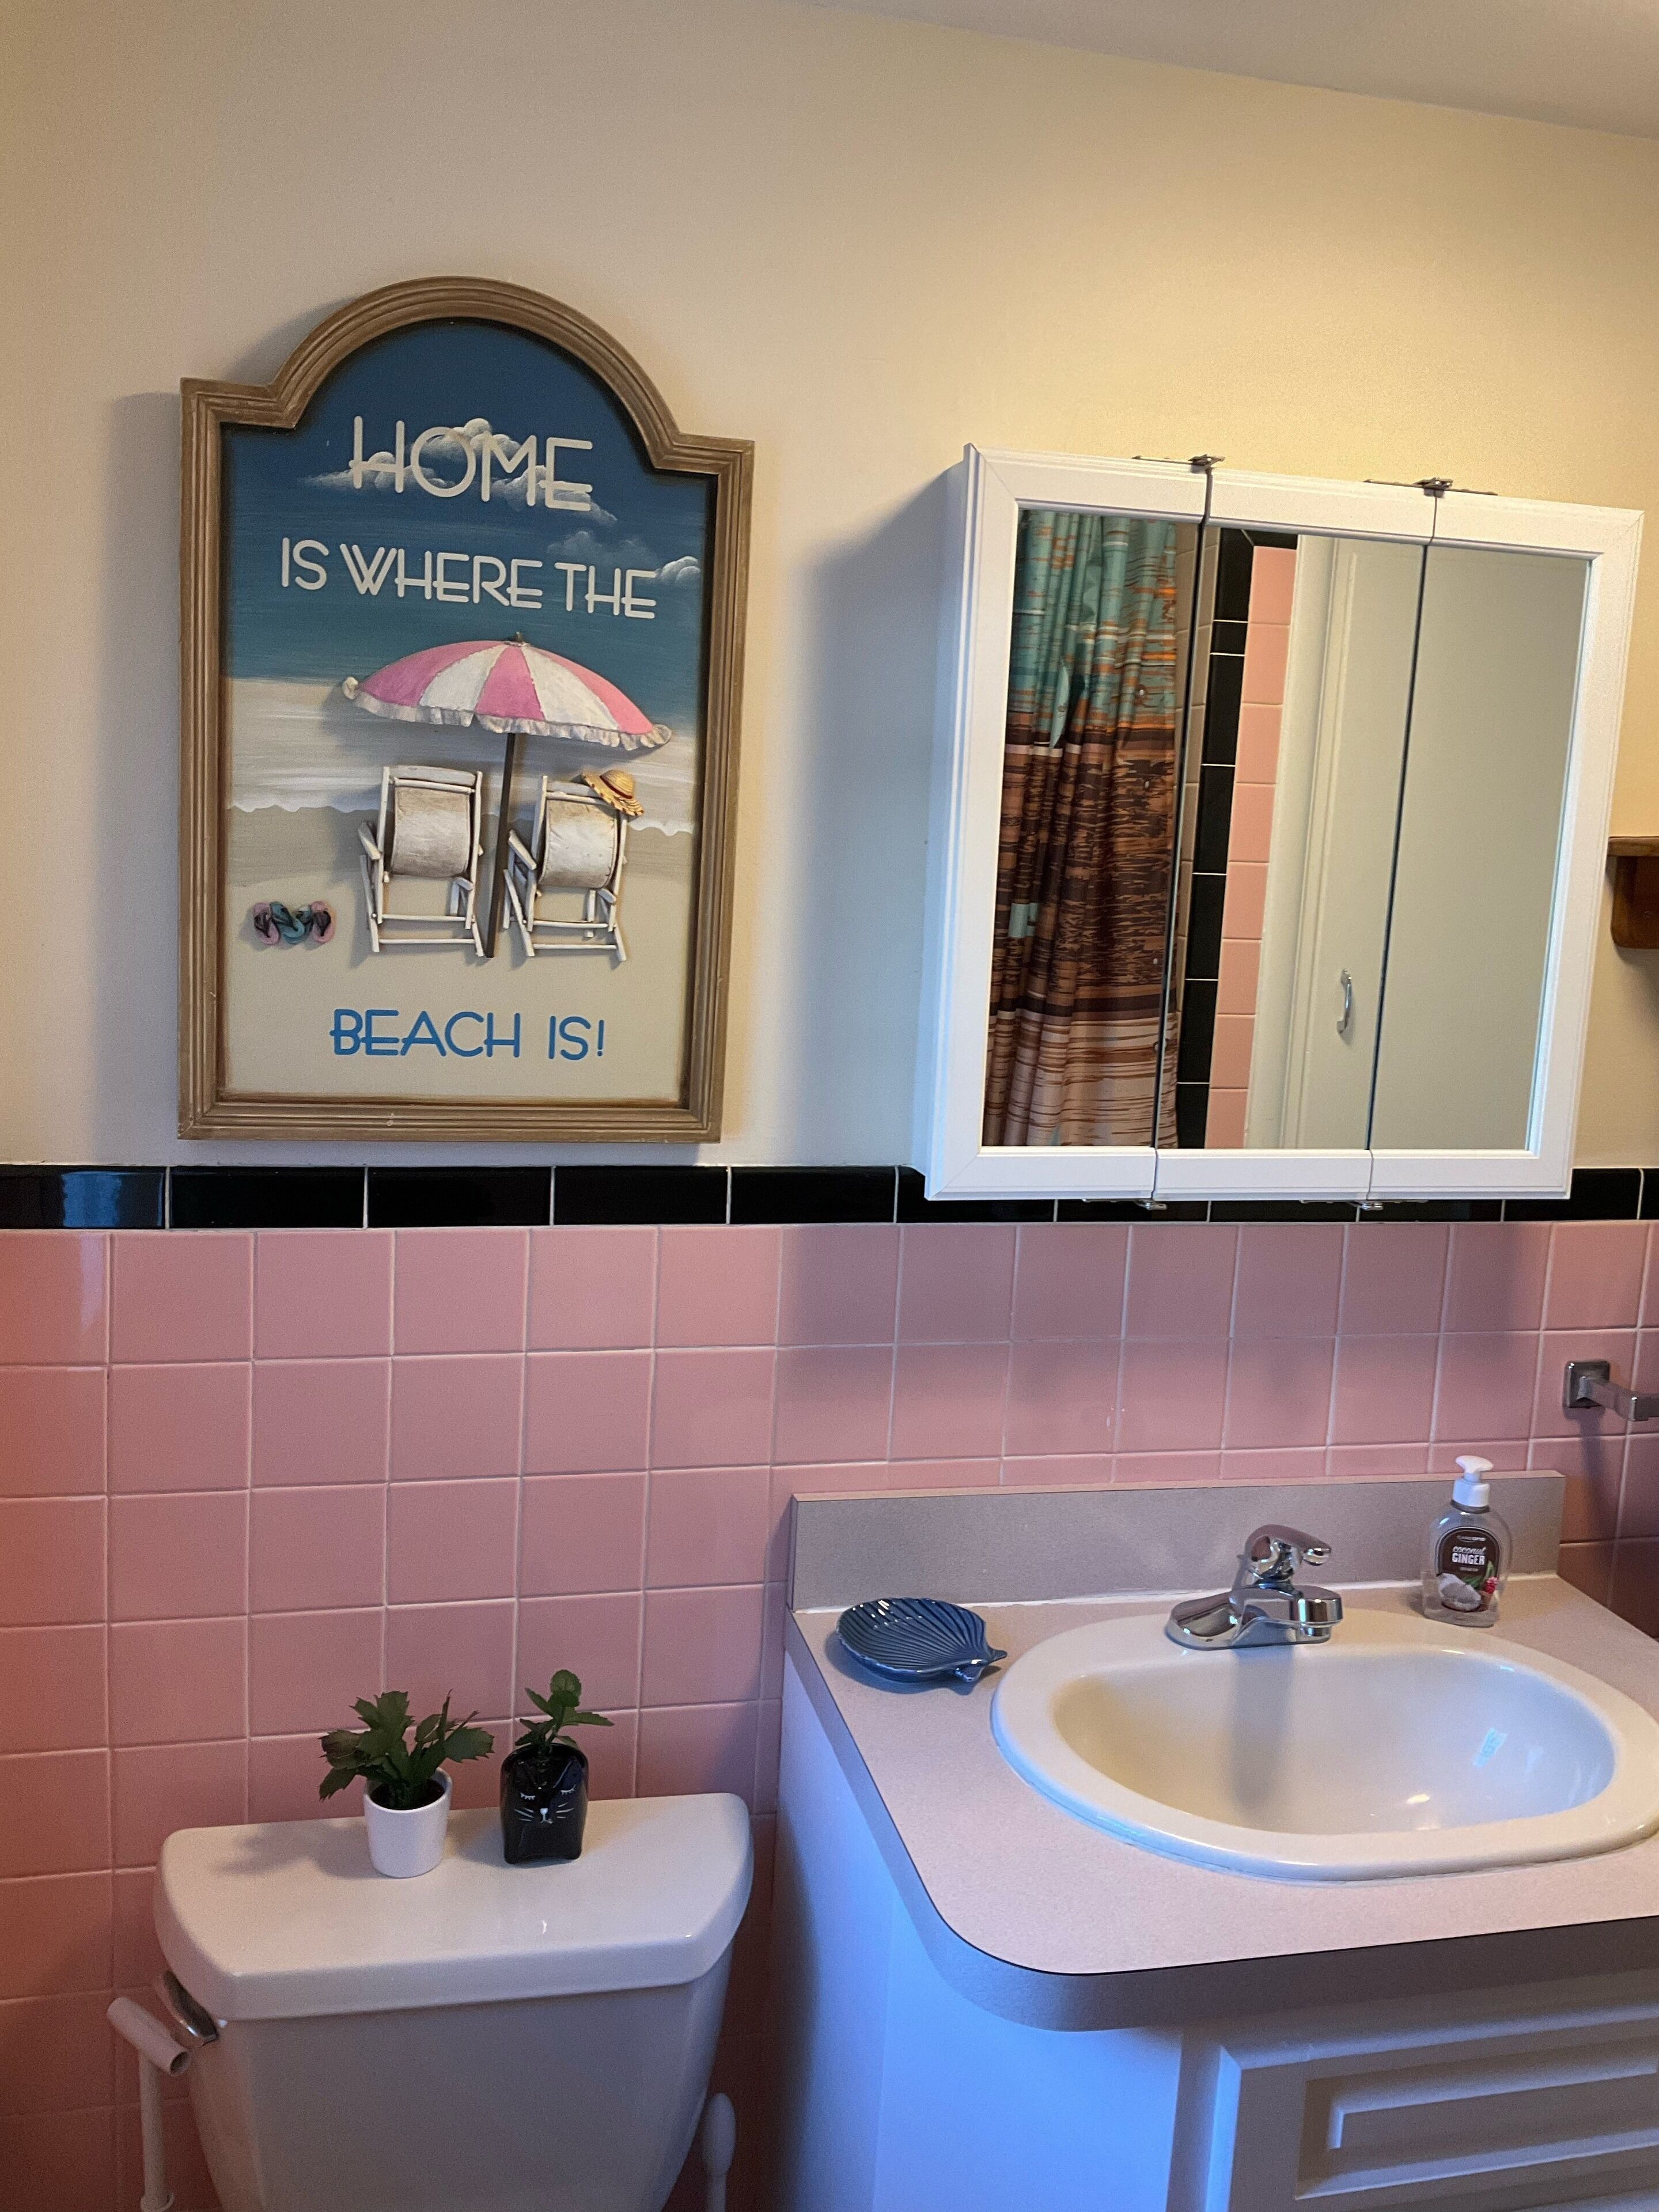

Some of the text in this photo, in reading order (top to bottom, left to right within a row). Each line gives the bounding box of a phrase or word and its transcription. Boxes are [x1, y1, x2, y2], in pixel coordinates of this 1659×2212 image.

[348, 416, 593, 512] HOME
[281, 537, 657, 619] IS WHERE THE
[329, 1009, 605, 1061] BEACH IS!
[1452, 1553, 1484, 1565] GINGER
